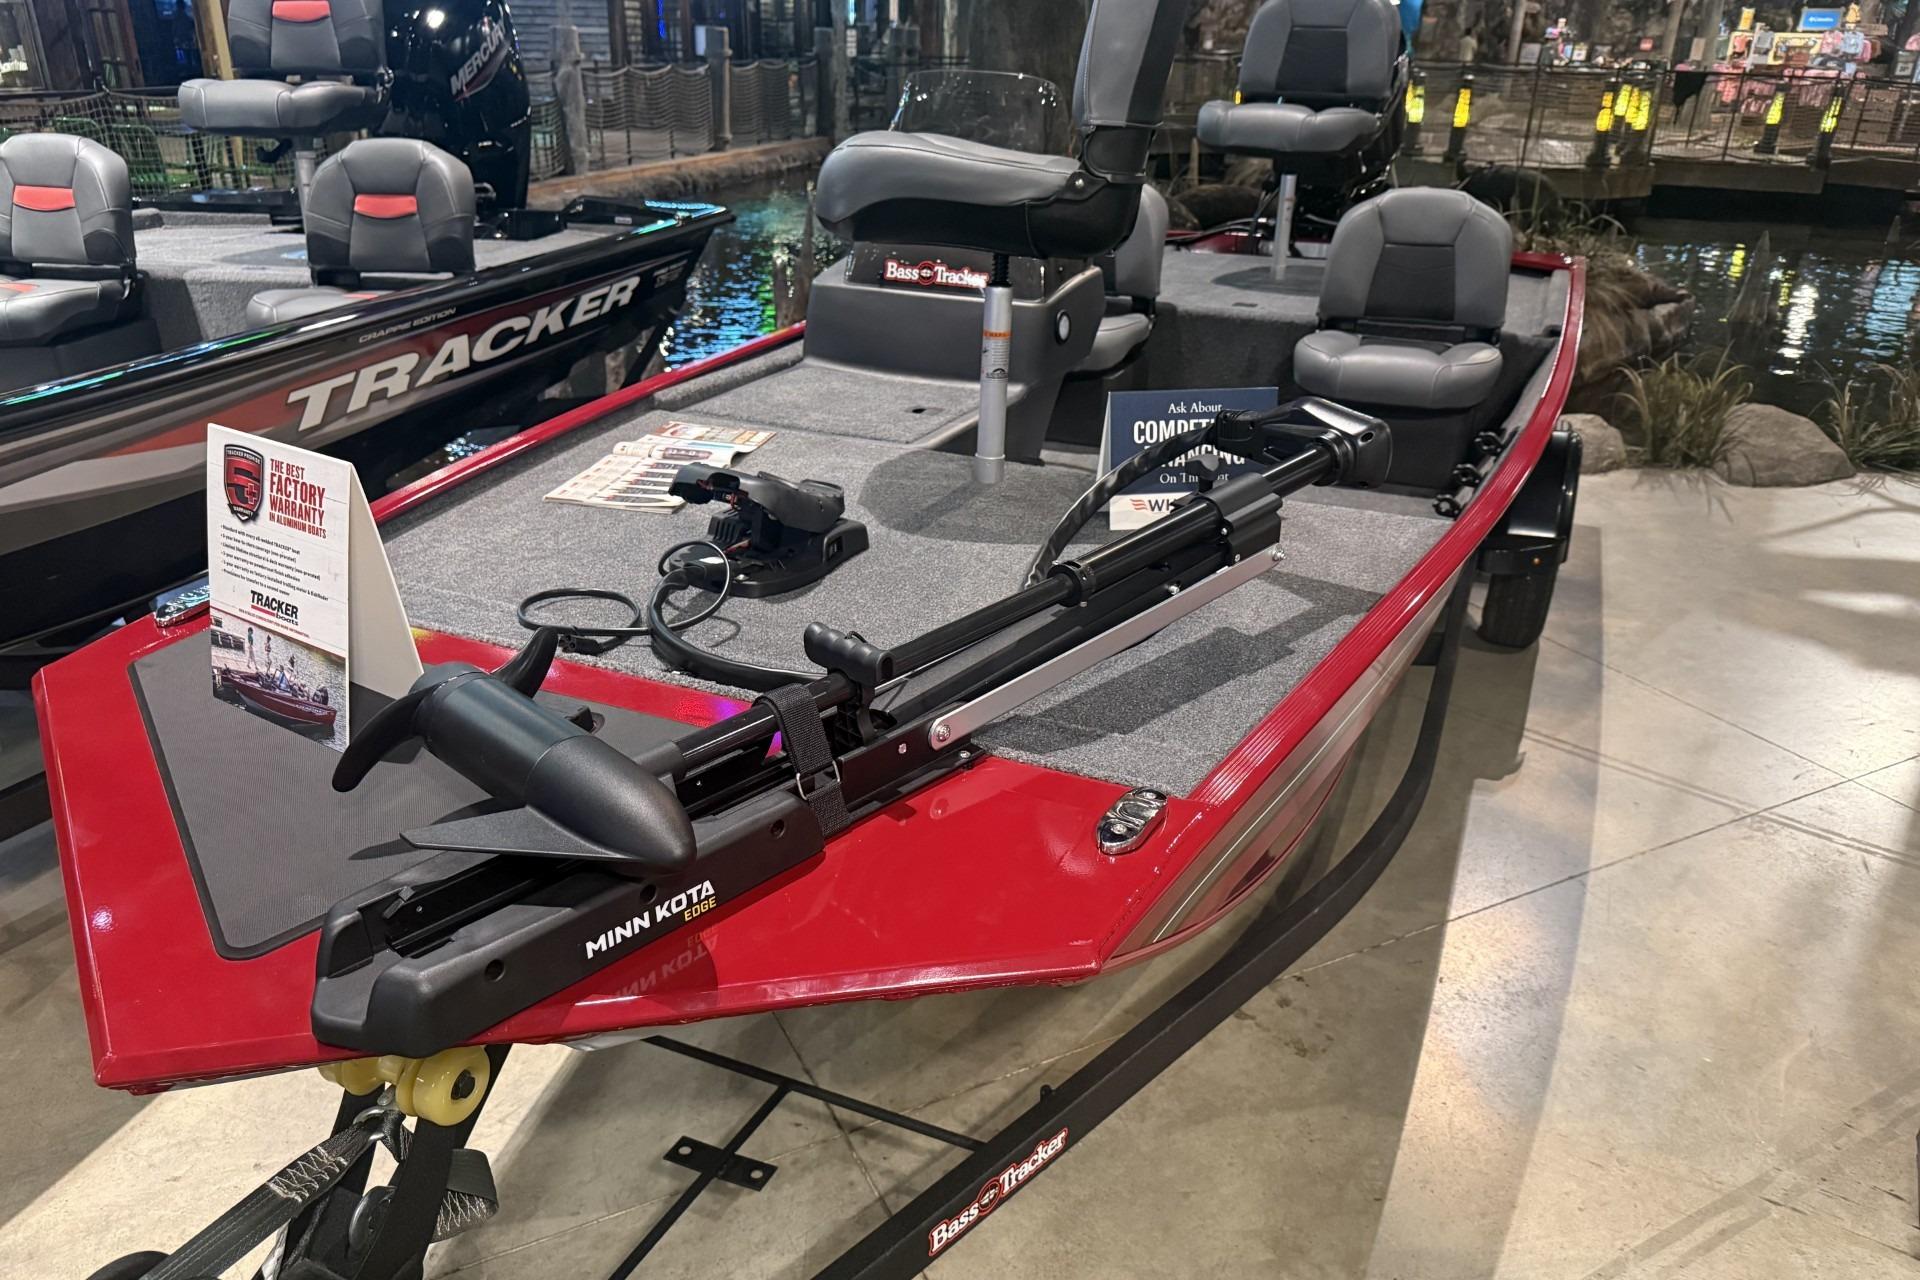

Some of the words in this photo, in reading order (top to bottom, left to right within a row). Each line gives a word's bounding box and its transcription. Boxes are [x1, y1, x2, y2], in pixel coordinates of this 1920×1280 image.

[886, 262, 919, 280] Bass
[935, 266, 988, 288] Tracker
[412, 307, 457, 327] EDITION
[287, 276, 641, 432] TRACKER
[1168, 401, 1187, 413] Ask
[1190, 400, 1222, 413] About
[270, 458, 284, 474] THE
[286, 463, 305, 480] BEST
[1160, 472, 1177, 484] On
[270, 472, 326, 508] FACTORY
[269, 493, 325, 526] WARRANTY
[269, 511, 276, 522] IN
[276, 515, 307, 533] ALUMINUM
[307, 523, 327, 539] BOATS
[250, 589, 299, 620] TRACKER
[275, 612, 299, 626] boats
[585, 911, 651, 960] MINN
[655, 880, 716, 923] KOTA
[684, 896, 717, 922] EDGE
[931, 1202, 979, 1252] Bass
[1000, 1131, 1066, 1195] Tracker
